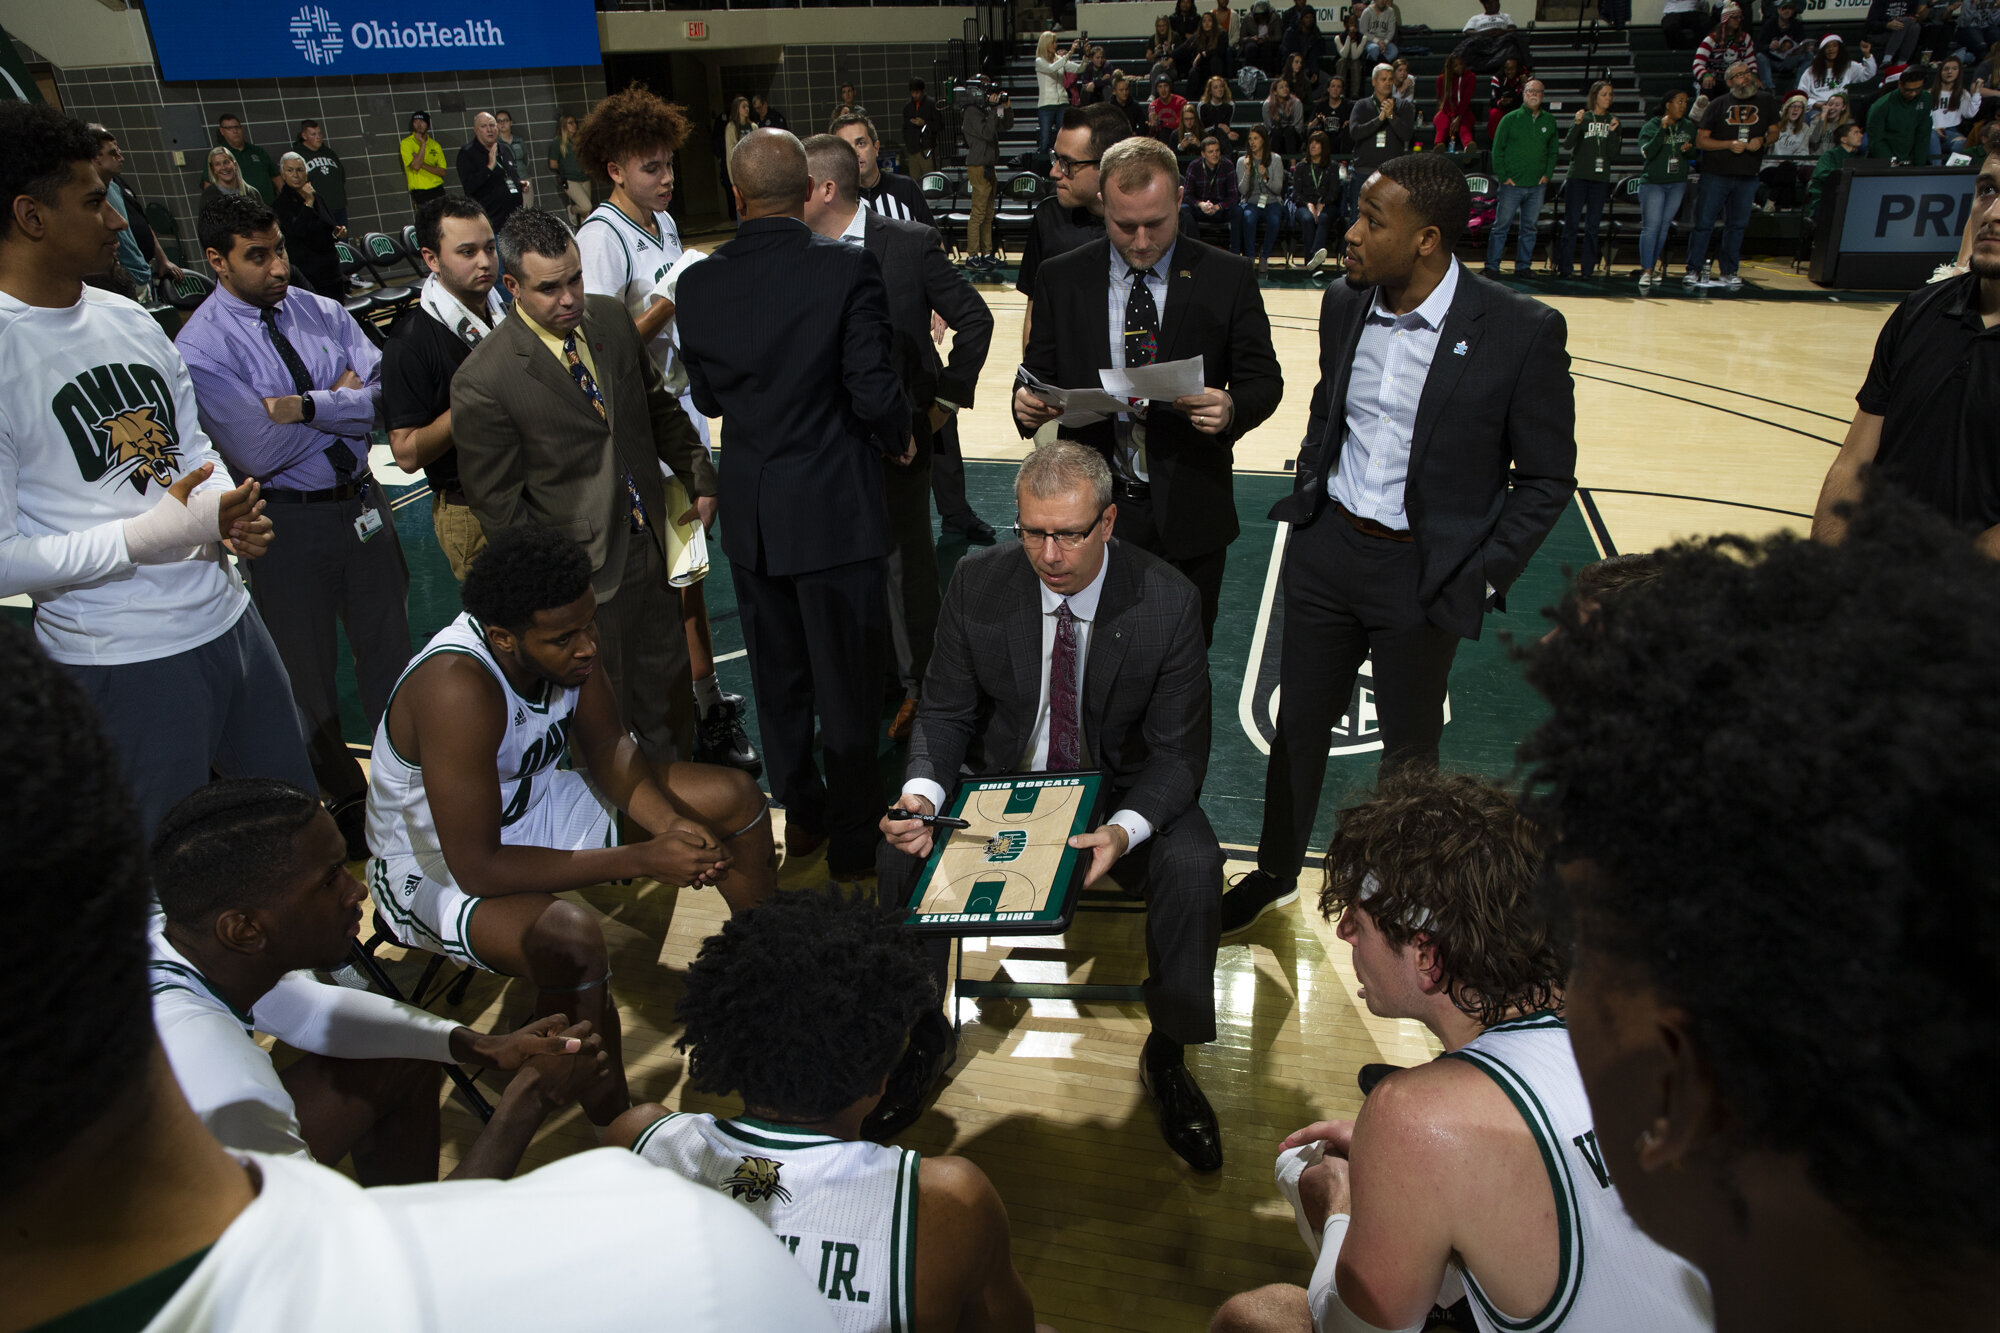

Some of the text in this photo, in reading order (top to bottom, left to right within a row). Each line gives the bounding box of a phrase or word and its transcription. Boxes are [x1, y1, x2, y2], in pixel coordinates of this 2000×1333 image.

[351, 19, 505, 49] OhioHealth
[688, 22, 704, 37] EXIT
[306, 156, 338, 173] OHIO
[1013, 176, 1036, 192] OHIO
[371, 237, 396, 257] OHIO
[174, 275, 205, 297] OHIO
[52, 363, 179, 483] OHIO
[978, 778, 1080, 791] OHIO BOBCATS
[920, 911, 1034, 923] OHIO BOBCATS
[818, 1240, 871, 1304] JR.
